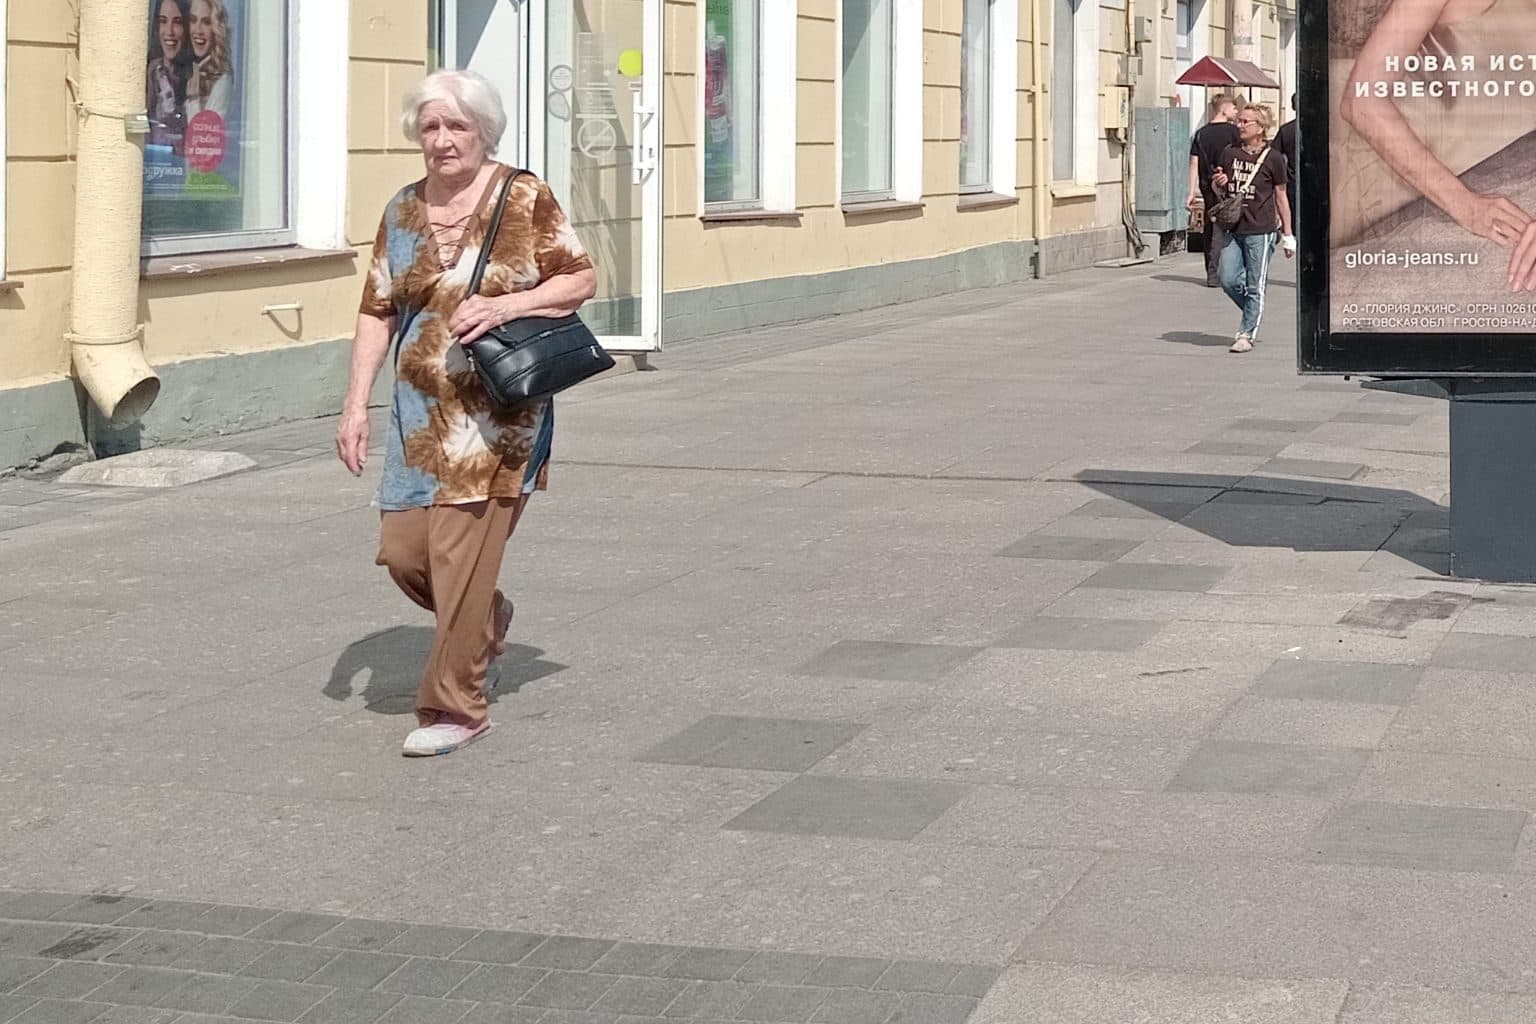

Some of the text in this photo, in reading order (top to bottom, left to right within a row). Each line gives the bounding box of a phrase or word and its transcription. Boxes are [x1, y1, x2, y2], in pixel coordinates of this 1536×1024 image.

[1385, 55, 1475, 72] НОВАЯ
[1355, 80, 1535, 98] ИЗВЕСТНОГО
[1345, 249, 1479, 269] gloria-jeans.ru
[1343, 303, 1358, 314] АО
[1466, 303, 1497, 314] ОГРН
